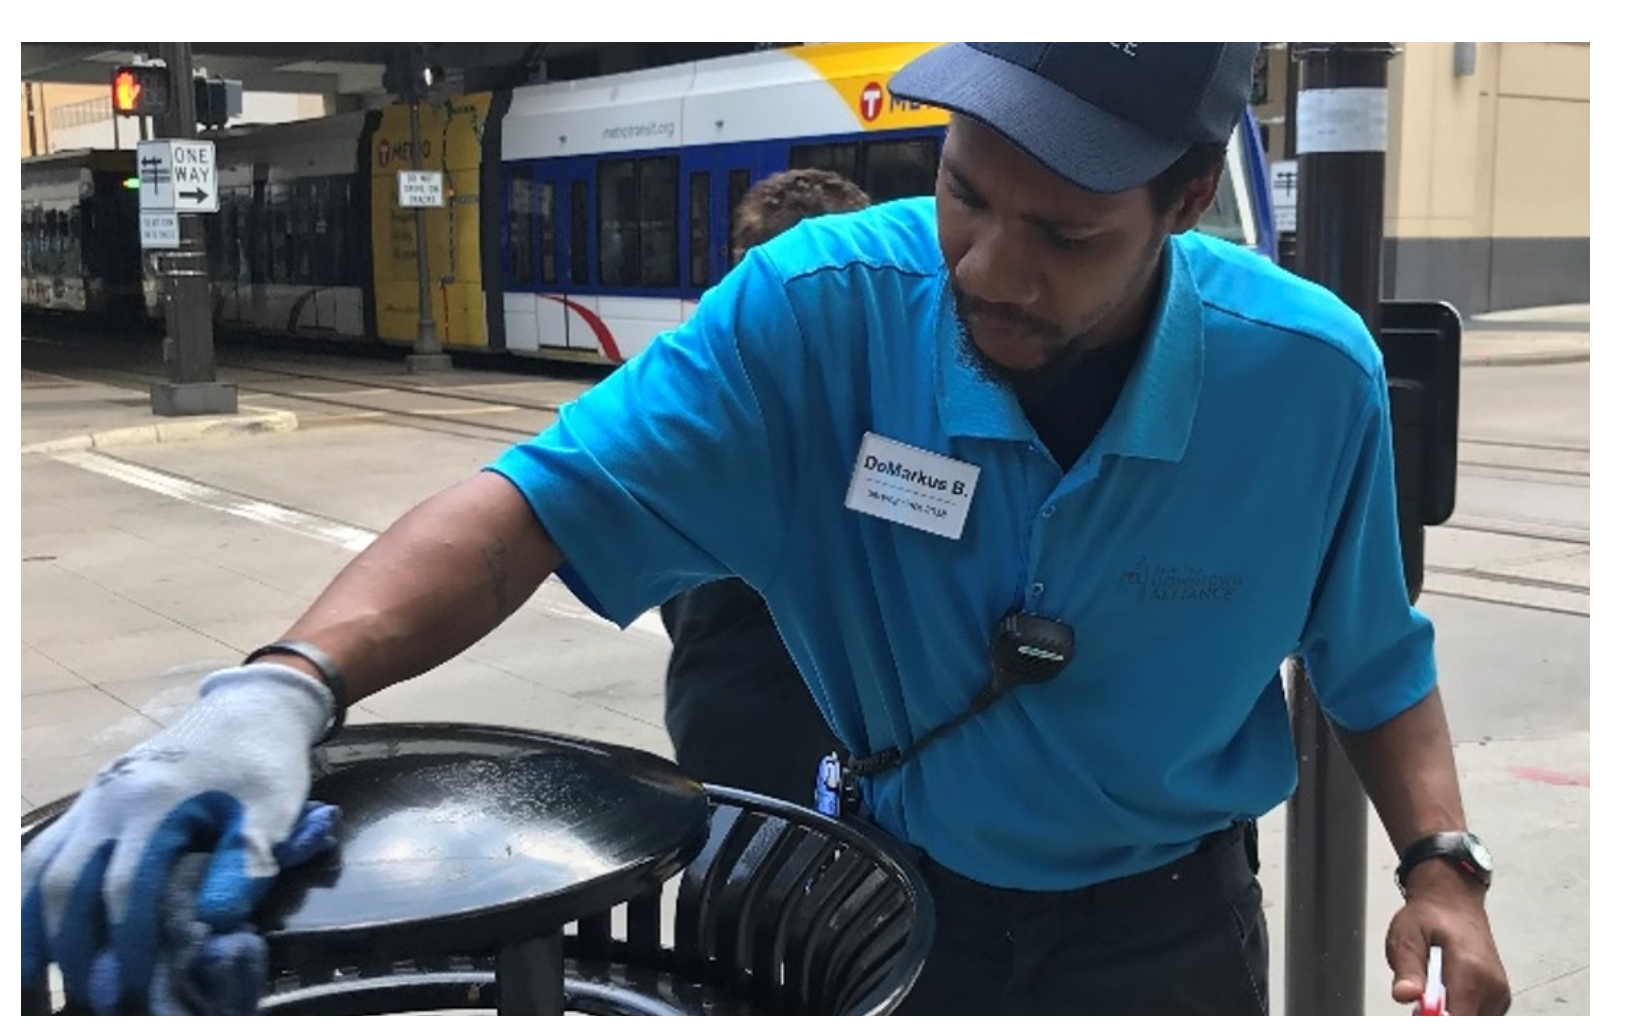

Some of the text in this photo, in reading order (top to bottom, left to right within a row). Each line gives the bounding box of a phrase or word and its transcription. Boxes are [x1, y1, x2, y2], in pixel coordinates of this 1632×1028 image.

[174, 146, 209, 164] ONE
[174, 166, 210, 183] WAY
[951, 480, 968, 497] B.
